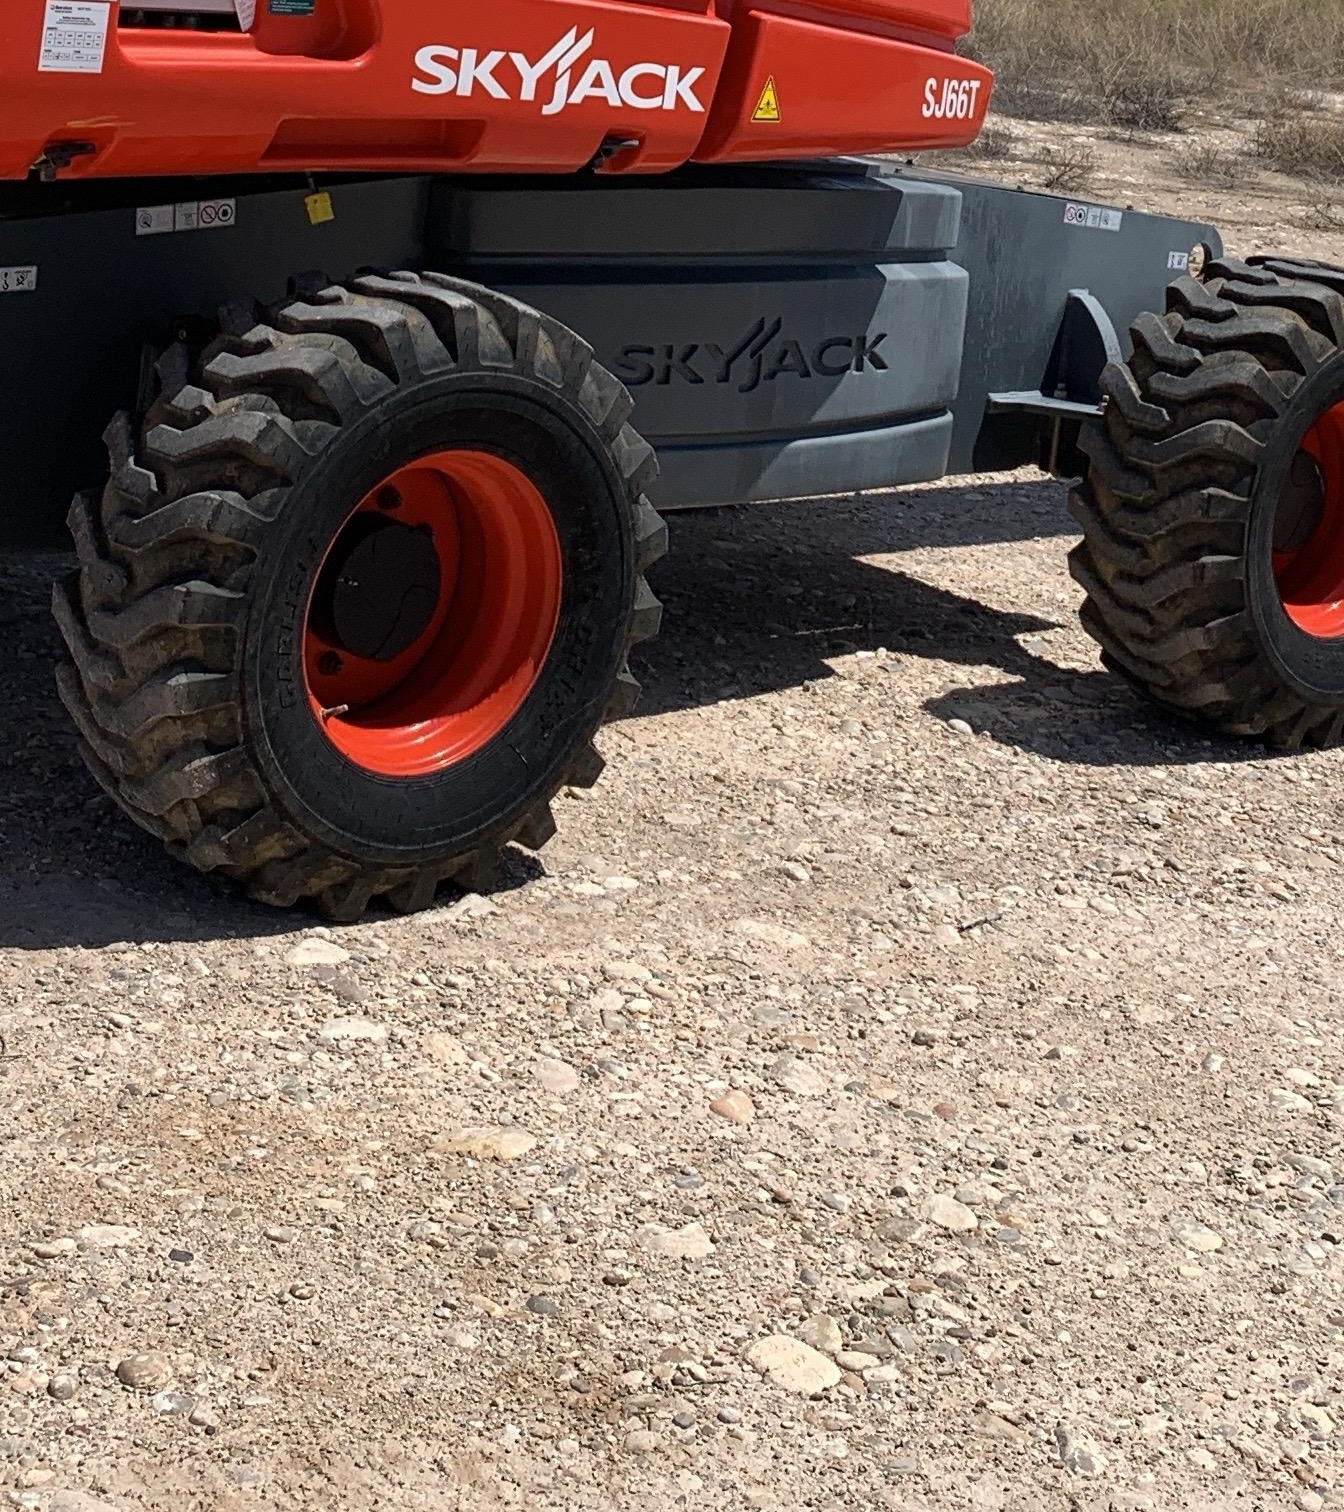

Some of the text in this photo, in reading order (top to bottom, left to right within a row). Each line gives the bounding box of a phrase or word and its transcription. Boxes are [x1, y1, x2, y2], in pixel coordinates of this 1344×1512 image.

[411, 24, 706, 116] SKYJACK
[921, 76, 981, 120] SJ66T
[609, 316, 889, 394] SKYJACK
